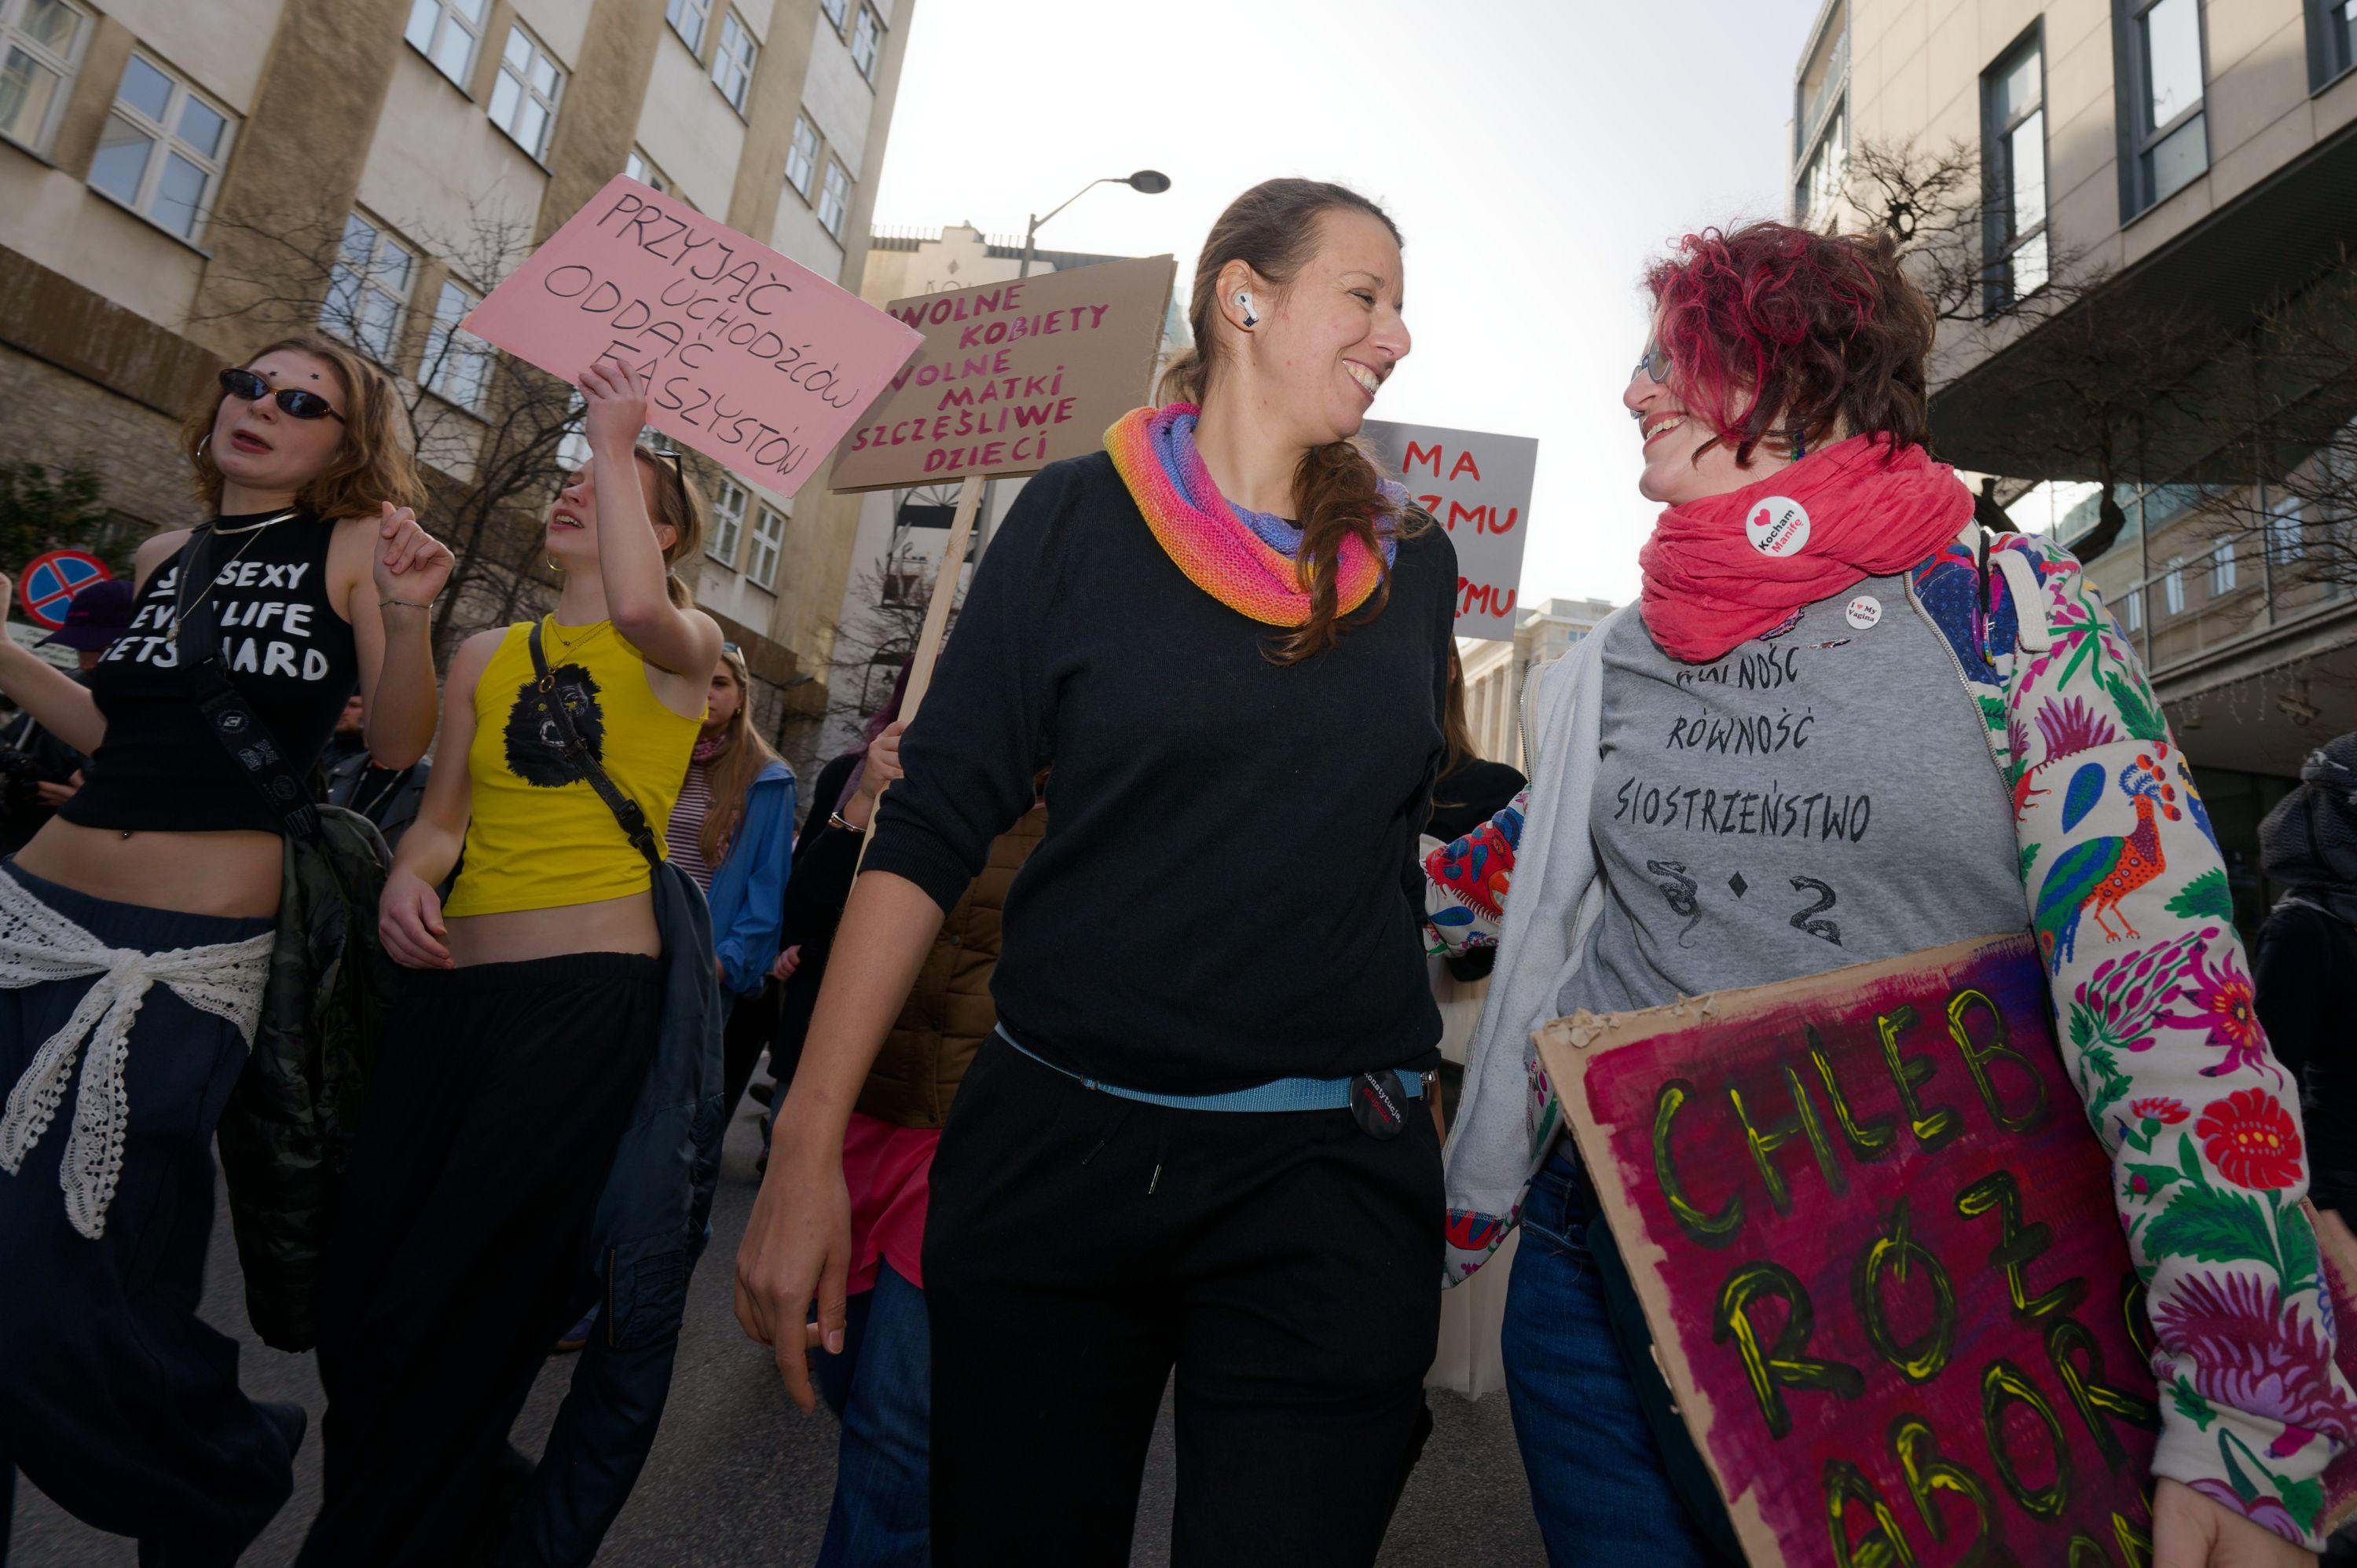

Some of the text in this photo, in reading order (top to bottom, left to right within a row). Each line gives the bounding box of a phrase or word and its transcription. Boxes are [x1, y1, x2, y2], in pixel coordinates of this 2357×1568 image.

[597, 193, 791, 315] PRZYJĄĆ
[544, 265, 713, 368] ODDAĆ
[890, 283, 1025, 328] WOLNE
[959, 304, 1109, 350] KOBIETY
[661, 278, 859, 408] UCHODŹCÓW
[851, 397, 1077, 452] SZCZĘŚLIWE
[1402, 440, 1480, 482] MA
[1758, 510, 1794, 551] Kocham
[216, 560, 310, 590] SEXY
[221, 601, 317, 638] LIFE
[1849, 609, 1875, 622] Vagina
[1864, 606, 1877, 614] My
[1666, 708, 1815, 755] RÓWNOŚĆ
[1614, 776, 1871, 843] SIOSTRZEŃSTWO
[1652, 988, 2047, 1249] CHLEB
